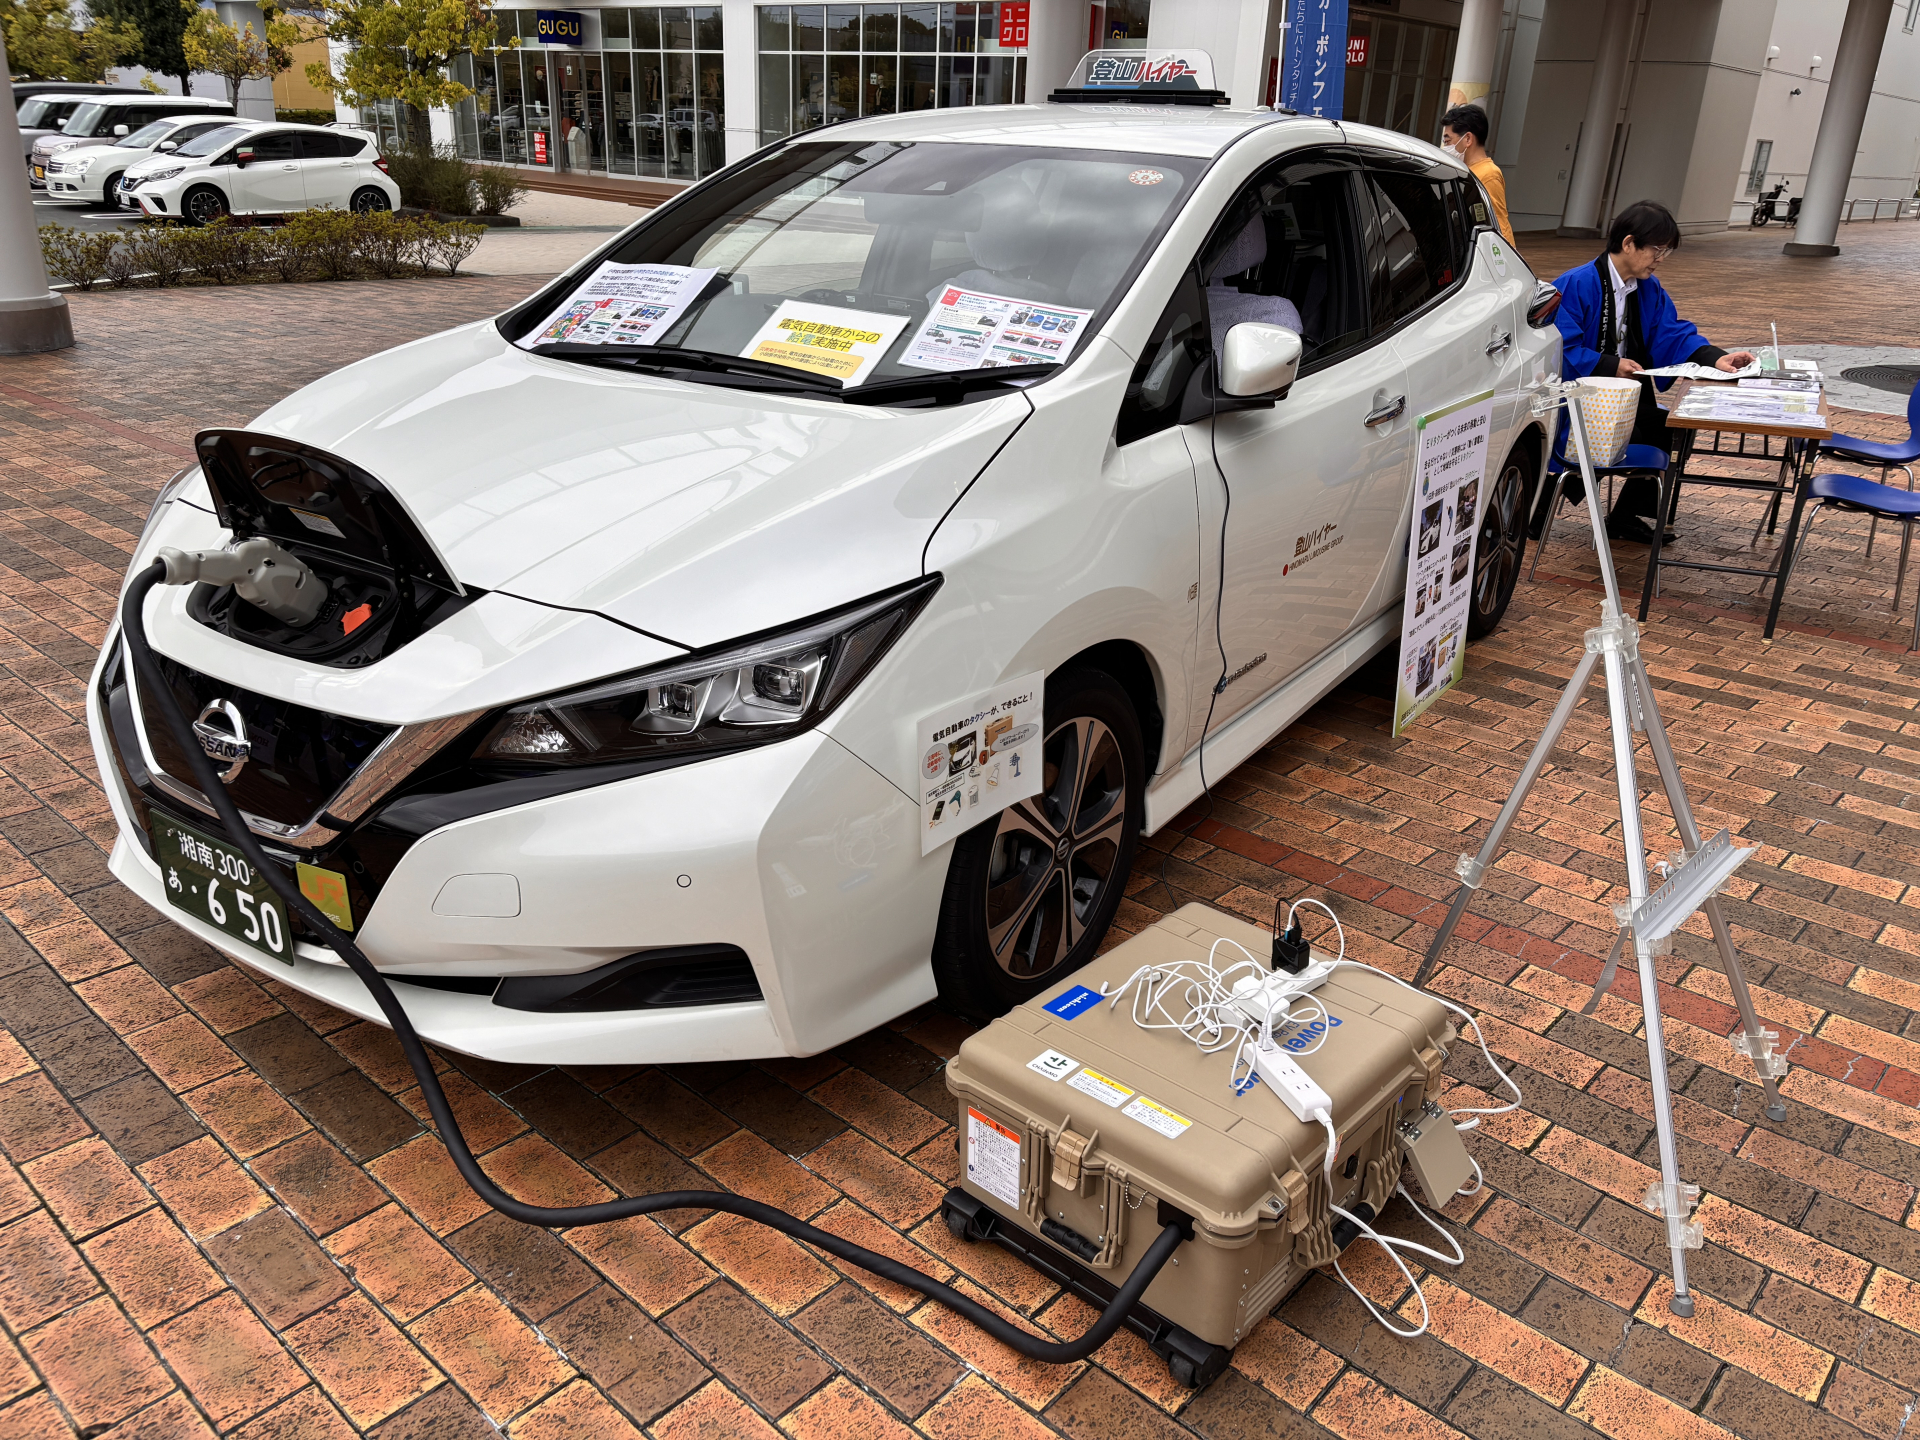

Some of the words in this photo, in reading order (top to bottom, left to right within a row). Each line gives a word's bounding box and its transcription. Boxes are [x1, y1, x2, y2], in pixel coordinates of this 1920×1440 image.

[538, 19, 554, 35] GU
[556, 20, 579, 37] GU
[1089, 58, 1198, 83] 登山ハイヤー
[779, 318, 881, 343] 電気自動車からの
[786, 332, 854, 352] 給電実施中
[932, 691, 1033, 742] 電気自動車のタクシーが、できること！
[177, 830, 215, 871] 湘南
[214, 848, 251, 886] 300
[168, 866, 183, 893] あ
[1056, 991, 1089, 1013] nichicon
[1282, 1012, 1344, 1053] Power
[1031, 1063, 1059, 1078] CHAdeMO
